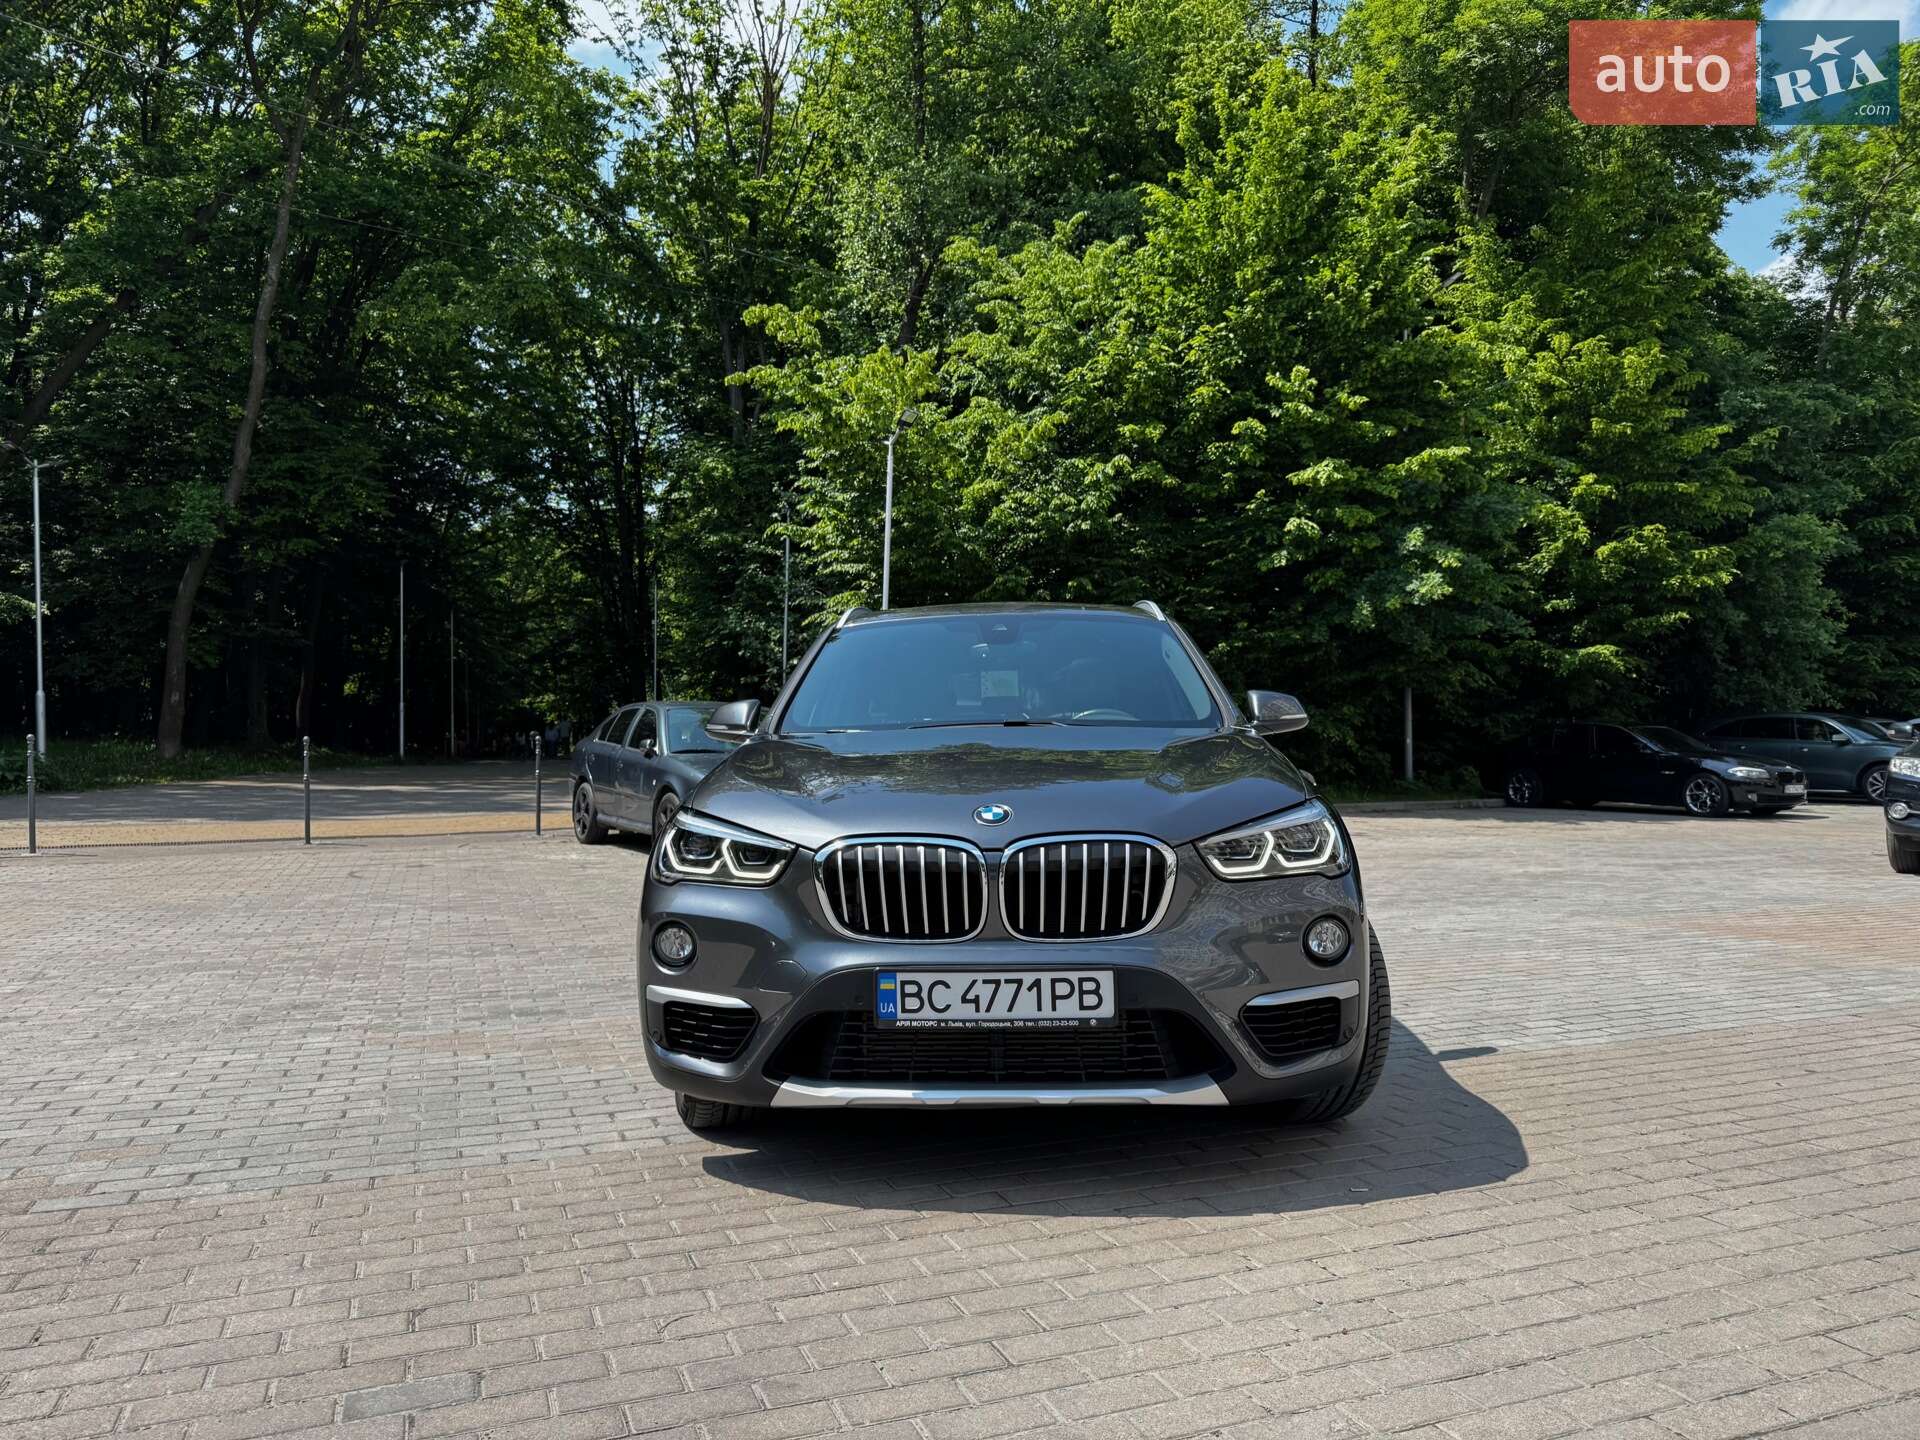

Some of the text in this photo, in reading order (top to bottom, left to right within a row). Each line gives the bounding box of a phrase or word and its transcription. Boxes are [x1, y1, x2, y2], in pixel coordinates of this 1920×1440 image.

[900, 976, 1104, 1013] BC 4771 PB
[880, 1002, 895, 1013] UA
